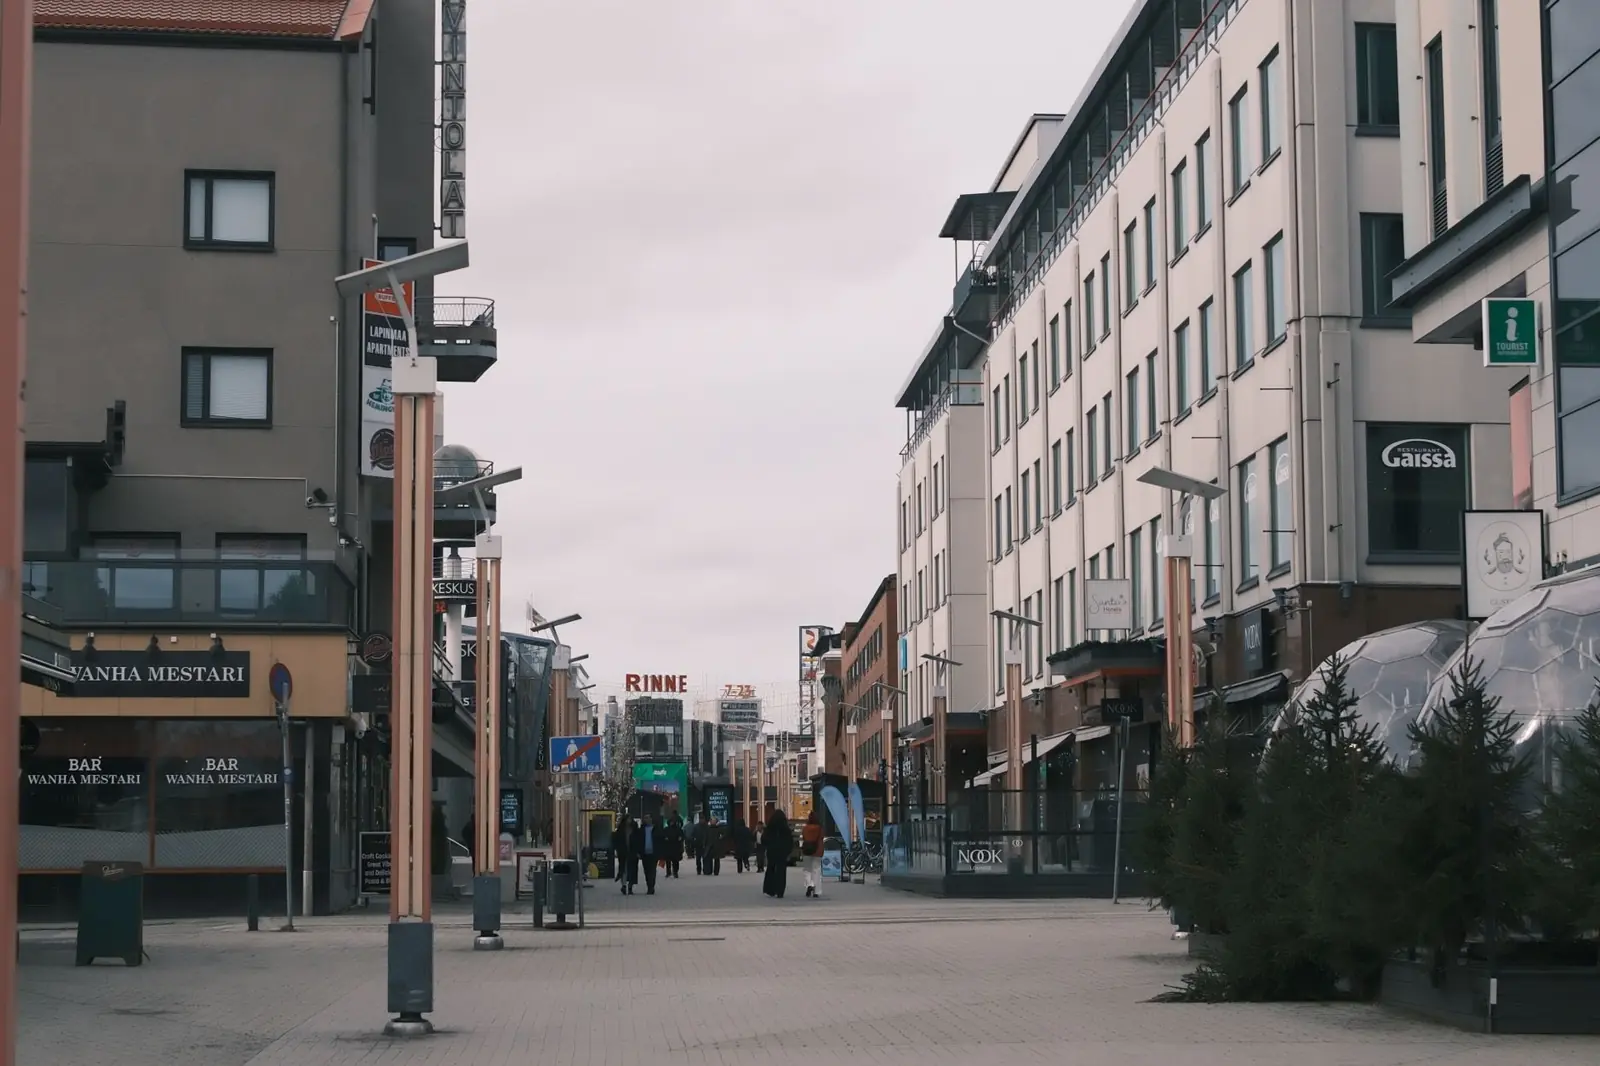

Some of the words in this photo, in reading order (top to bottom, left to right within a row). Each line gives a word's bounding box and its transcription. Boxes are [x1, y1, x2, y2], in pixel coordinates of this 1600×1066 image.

[443, 0, 465, 236] VINTOLAT
[1496, 342, 1529, 351] TOURIST
[366, 398, 395, 413] HEMING
[1381, 442, 1457, 468] Gaissa
[147, 666, 245, 682] MESTARI
[625, 673, 688, 693] RINNE
[1106, 703, 1138, 714] NOOK
[68, 758, 102, 771] BAR
[205, 758, 239, 771] BAR
[28, 775, 77, 785] WANHA
[80, 774, 141, 785] MESTARI
[166, 774, 215, 784] WANHA
[218, 773, 278, 784] MESTARI
[958, 849, 1003, 863] NOOK
